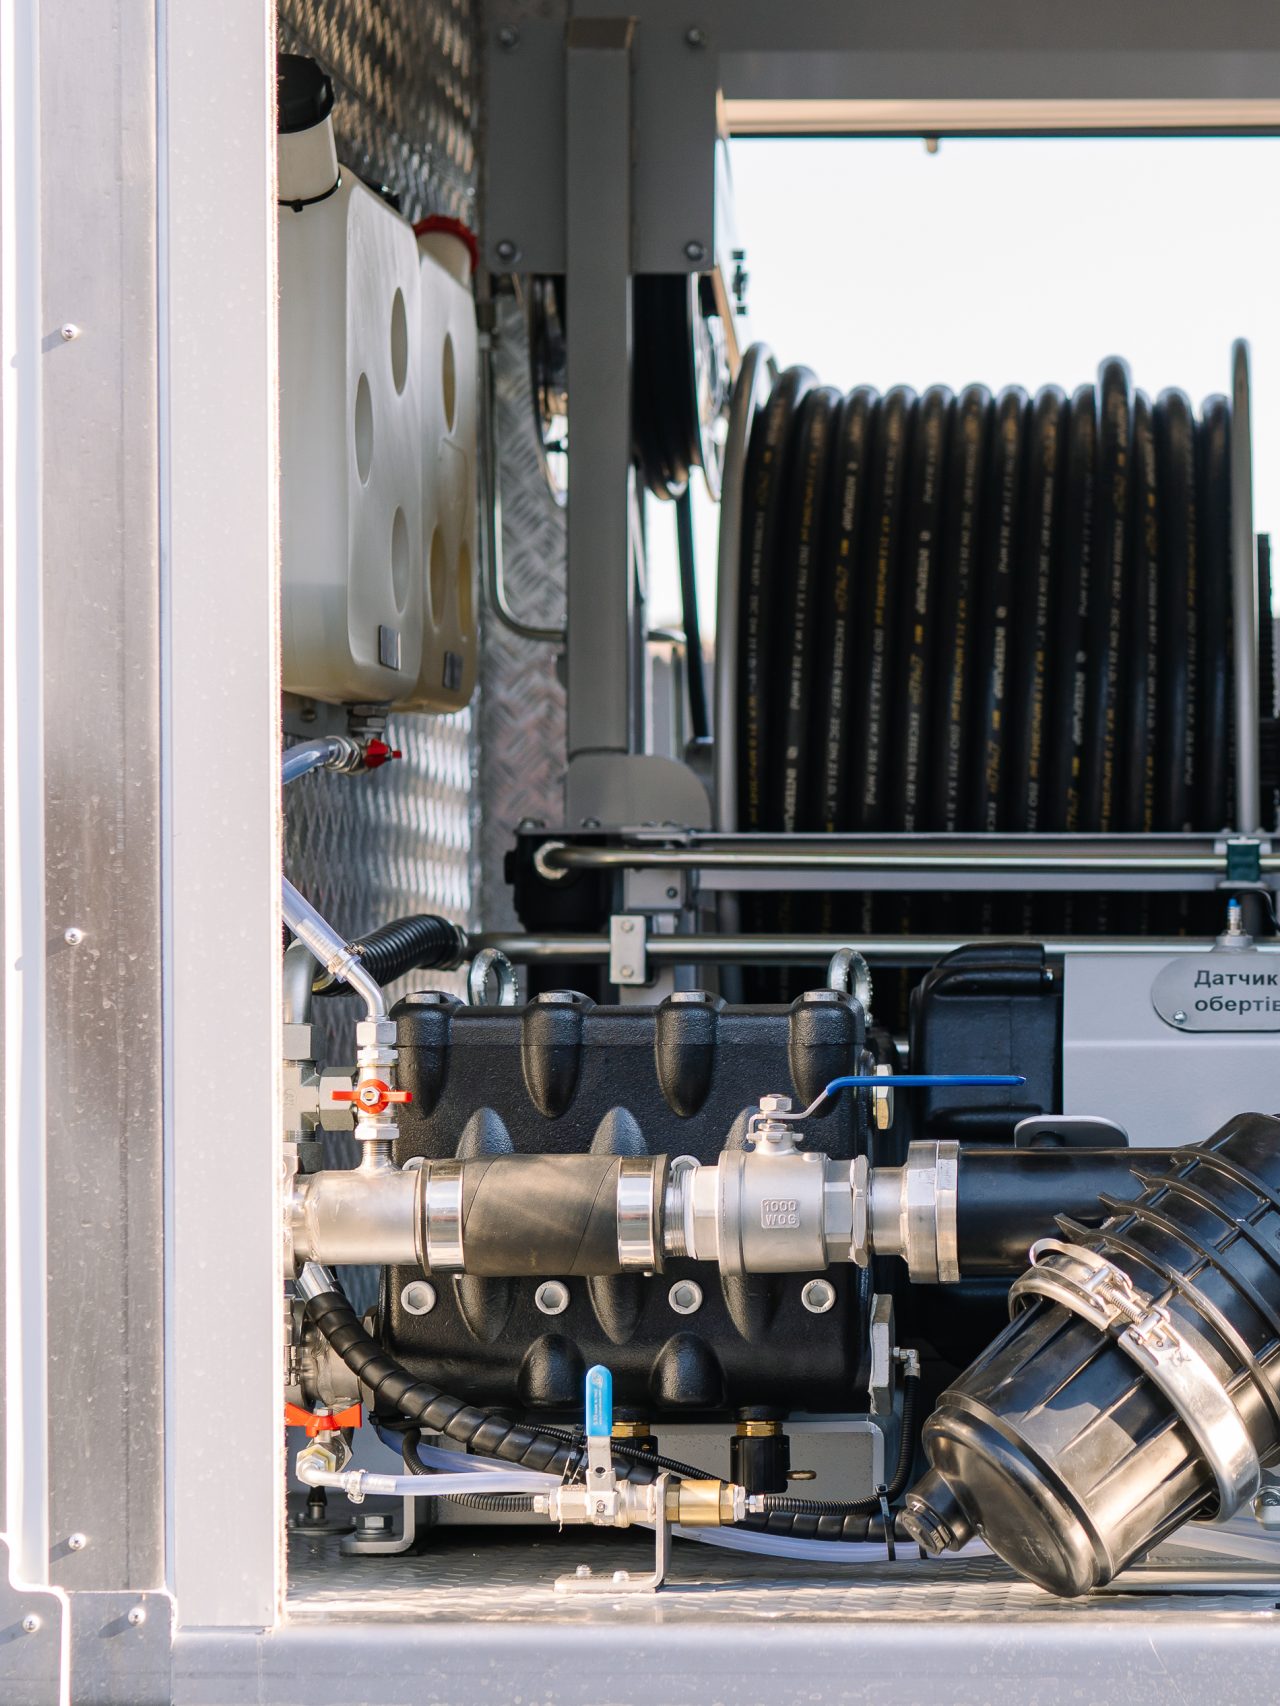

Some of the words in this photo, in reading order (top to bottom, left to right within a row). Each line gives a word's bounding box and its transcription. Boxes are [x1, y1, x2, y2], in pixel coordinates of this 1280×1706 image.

[842, 475, 856, 532] INTERPUMP
[916, 547, 929, 615] INTERPUMP
[993, 626, 1006, 700] INTERPUMP
[1073, 671, 1085, 747] INTERPUMP
[785, 767, 797, 832] INTERPUM
[1194, 970, 1279, 989] Датчик
[763, 1200, 797, 1212] 1000
[765, 1214, 798, 1226] WOG
